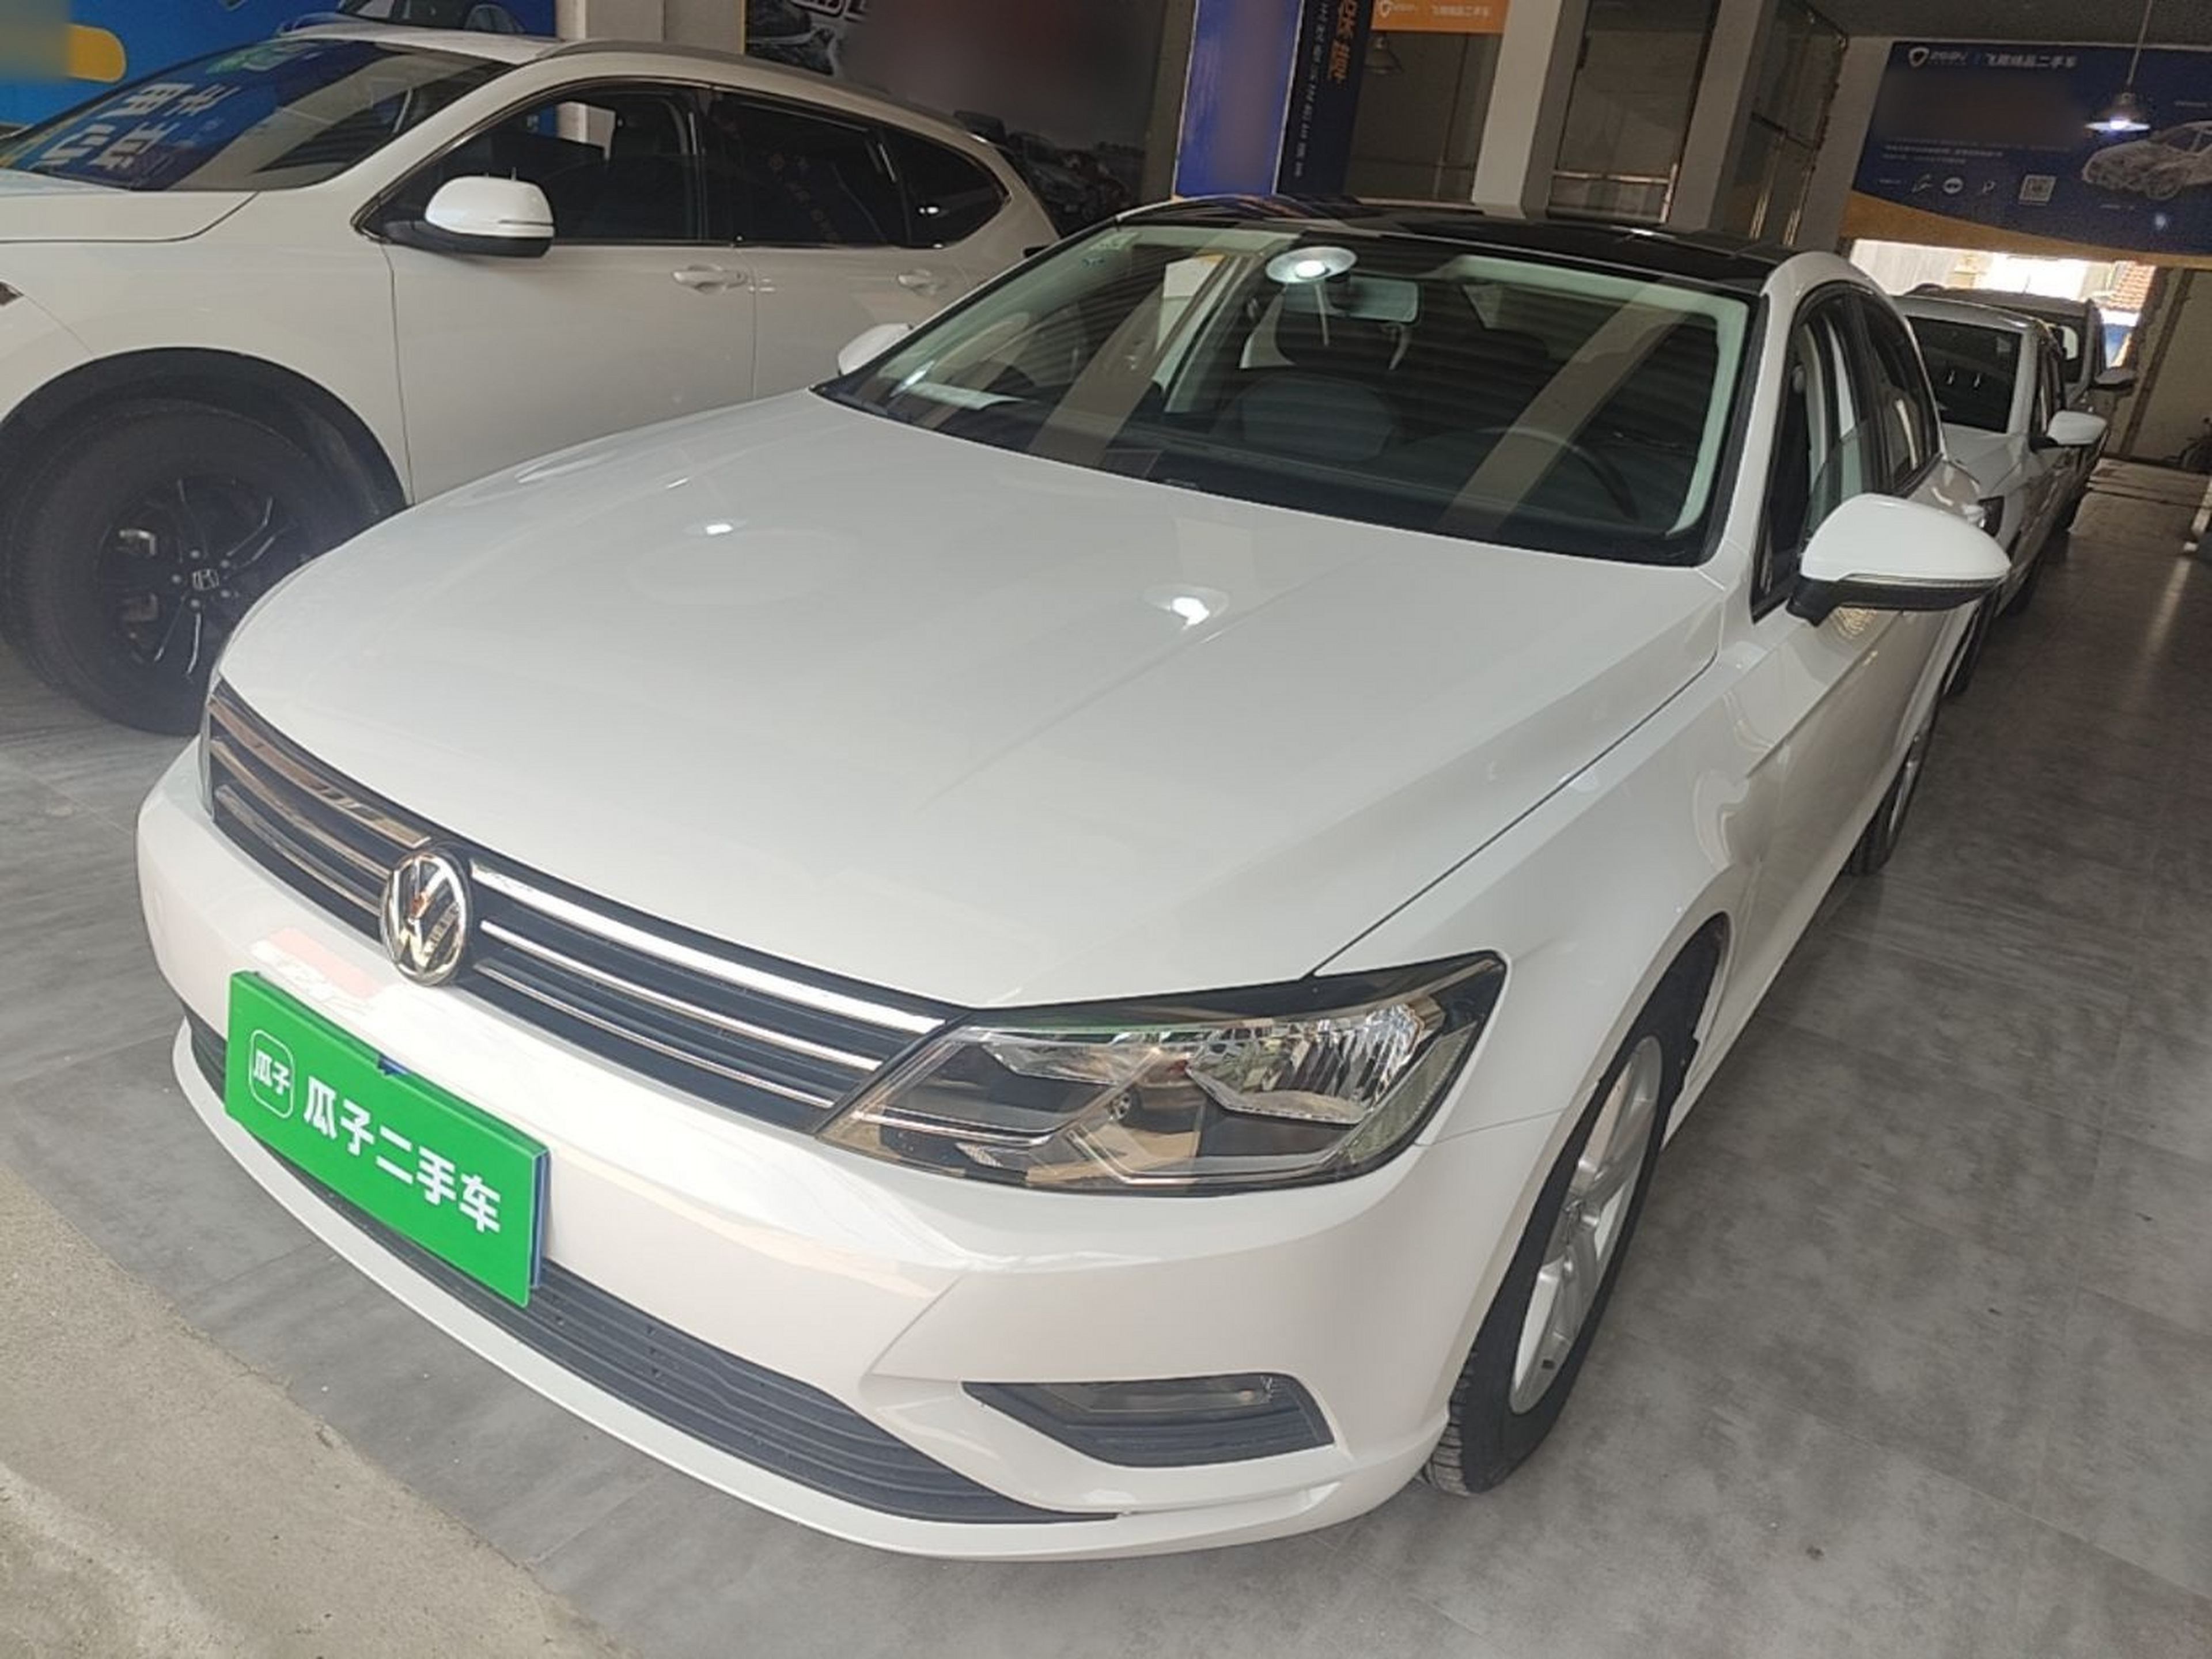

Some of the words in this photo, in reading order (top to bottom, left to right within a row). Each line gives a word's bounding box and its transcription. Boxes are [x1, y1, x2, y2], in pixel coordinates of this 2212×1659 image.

[253, 1048, 291, 1096] 瓜子
[303, 1075, 501, 1233] 瓜子二手车
